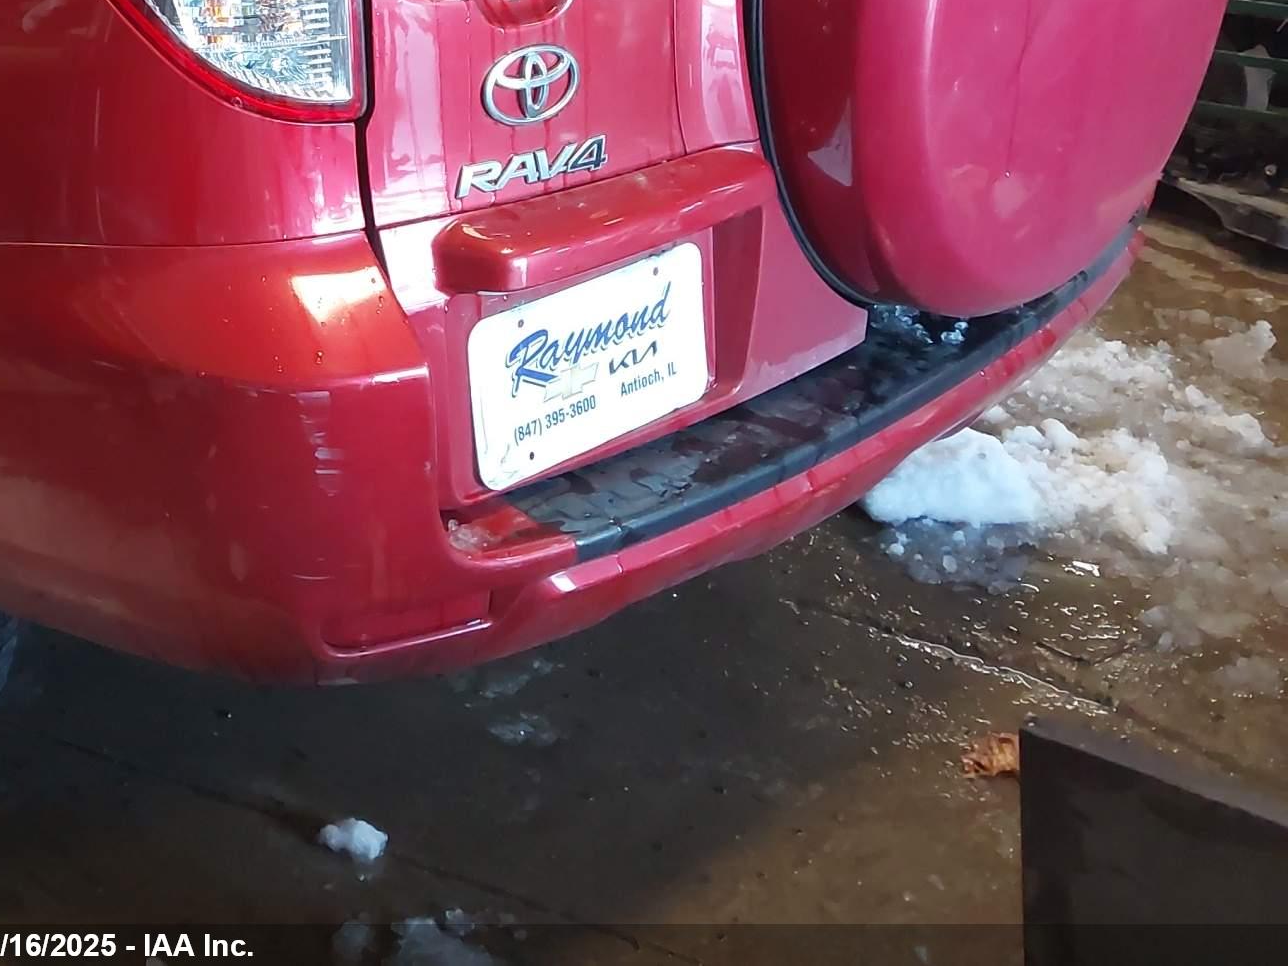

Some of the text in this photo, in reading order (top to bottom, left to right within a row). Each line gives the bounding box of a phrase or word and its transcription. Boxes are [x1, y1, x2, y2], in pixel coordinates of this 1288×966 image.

[455, 134, 608, 199] RAV4
[505, 280, 672, 398] Raymond
[620, 361, 678, 397] Antioch, IL
[514, 394, 596, 446] (847) 395-3600
